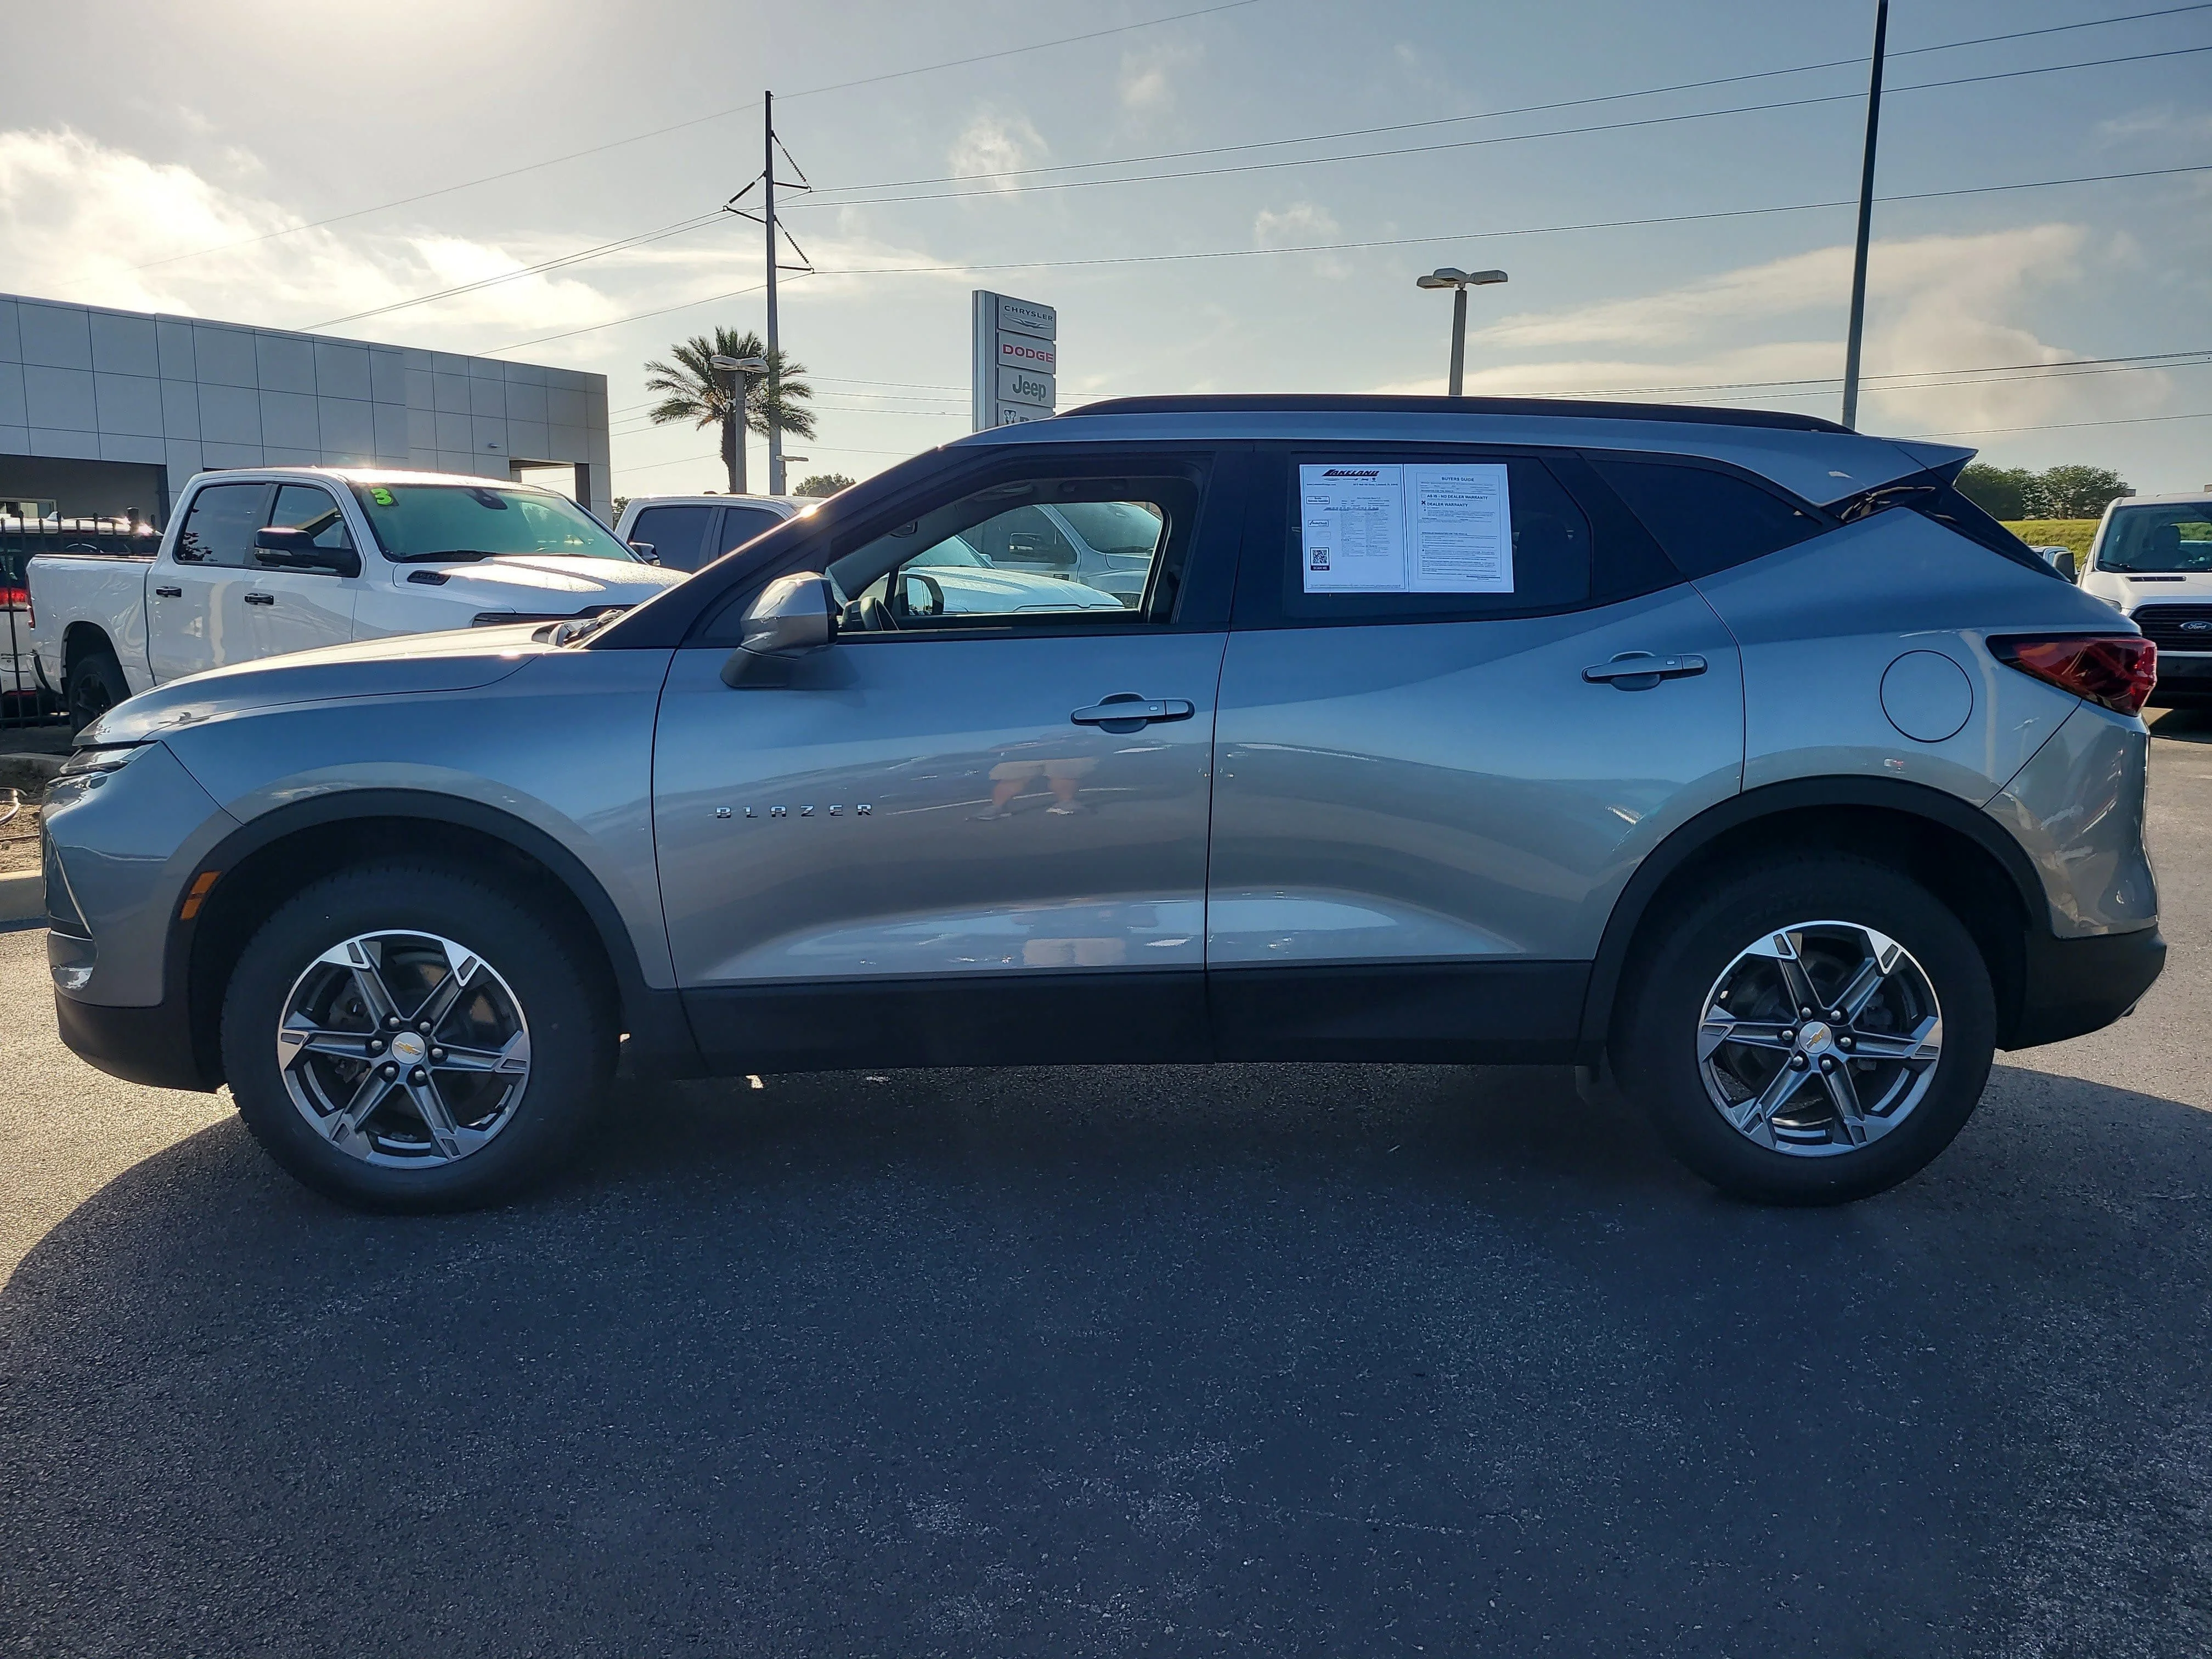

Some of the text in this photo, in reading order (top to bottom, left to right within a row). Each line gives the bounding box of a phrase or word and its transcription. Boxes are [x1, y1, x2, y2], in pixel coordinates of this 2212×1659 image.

[1004, 305, 1053, 322] CHRYSLER
[1003, 344, 1054, 363] DODGE
[1012, 375, 1046, 401] Jeep
[371, 488, 392, 505] 3
[715, 804, 872, 819] BLAZER
